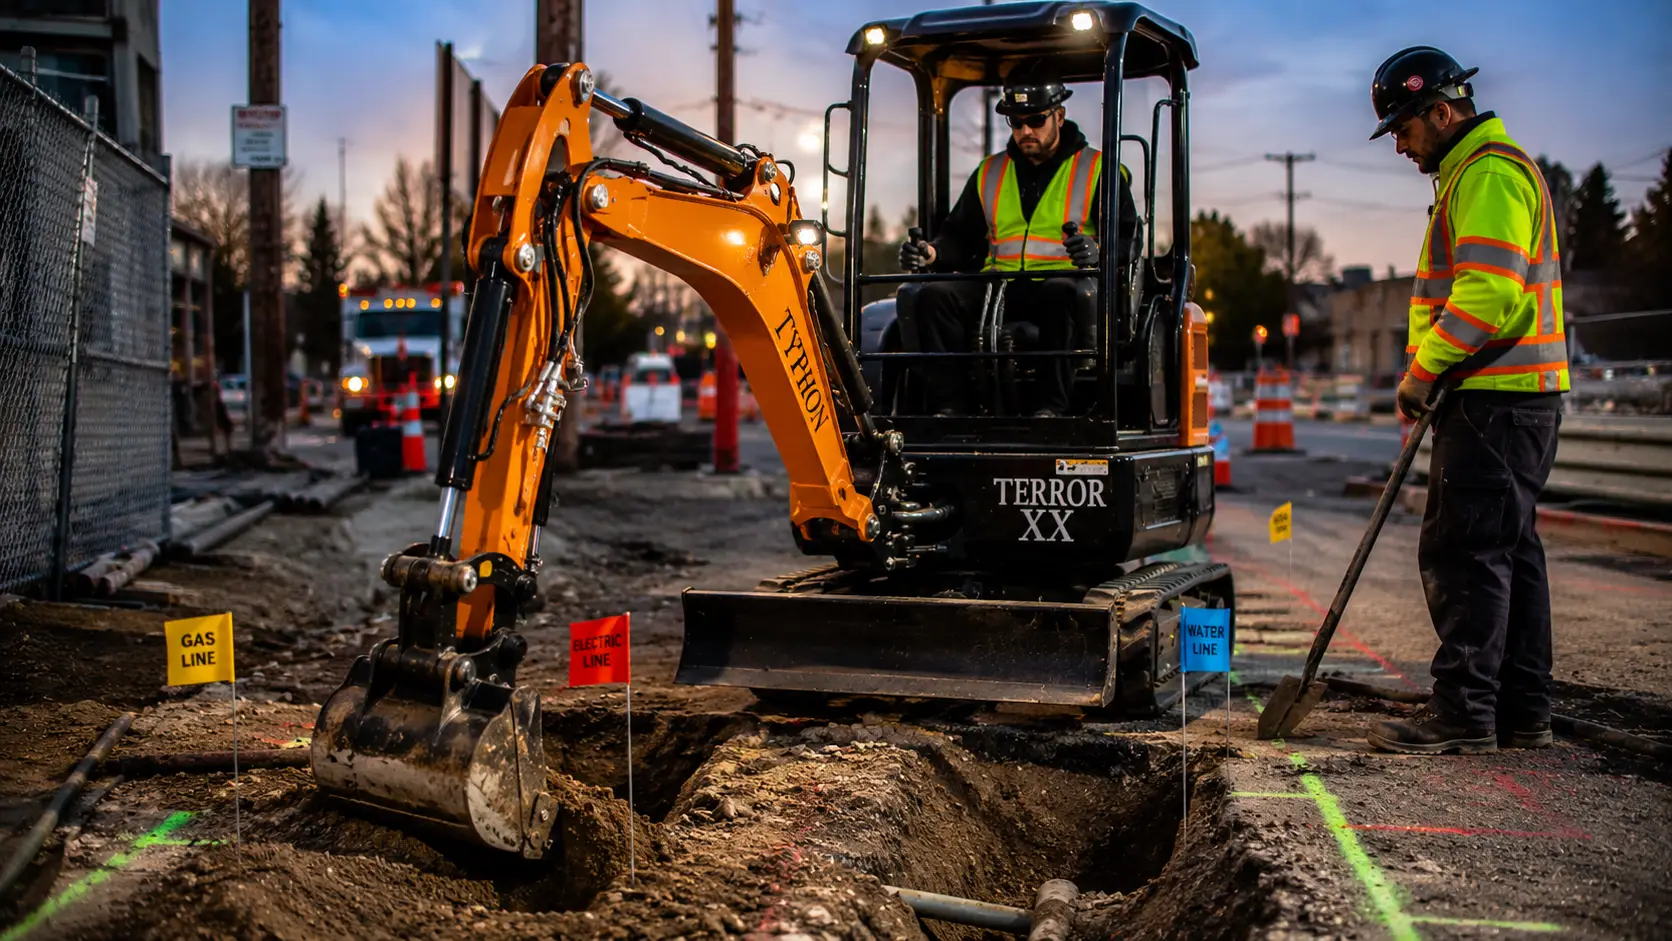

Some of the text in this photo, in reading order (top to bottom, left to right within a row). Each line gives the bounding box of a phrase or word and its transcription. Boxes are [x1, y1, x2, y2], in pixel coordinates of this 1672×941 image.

[774, 307, 829, 432] TYPHON
[993, 478, 1107, 507] TERROR
[1018, 508, 1074, 542] XX
[181, 631, 216, 648] GAS
[1187, 624, 1225, 639] WATER
[573, 633, 622, 652] ELECTRIC
[1192, 642, 1218, 656] LINE
[181, 651, 217, 668] LINE
[582, 653, 611, 669] LINE
